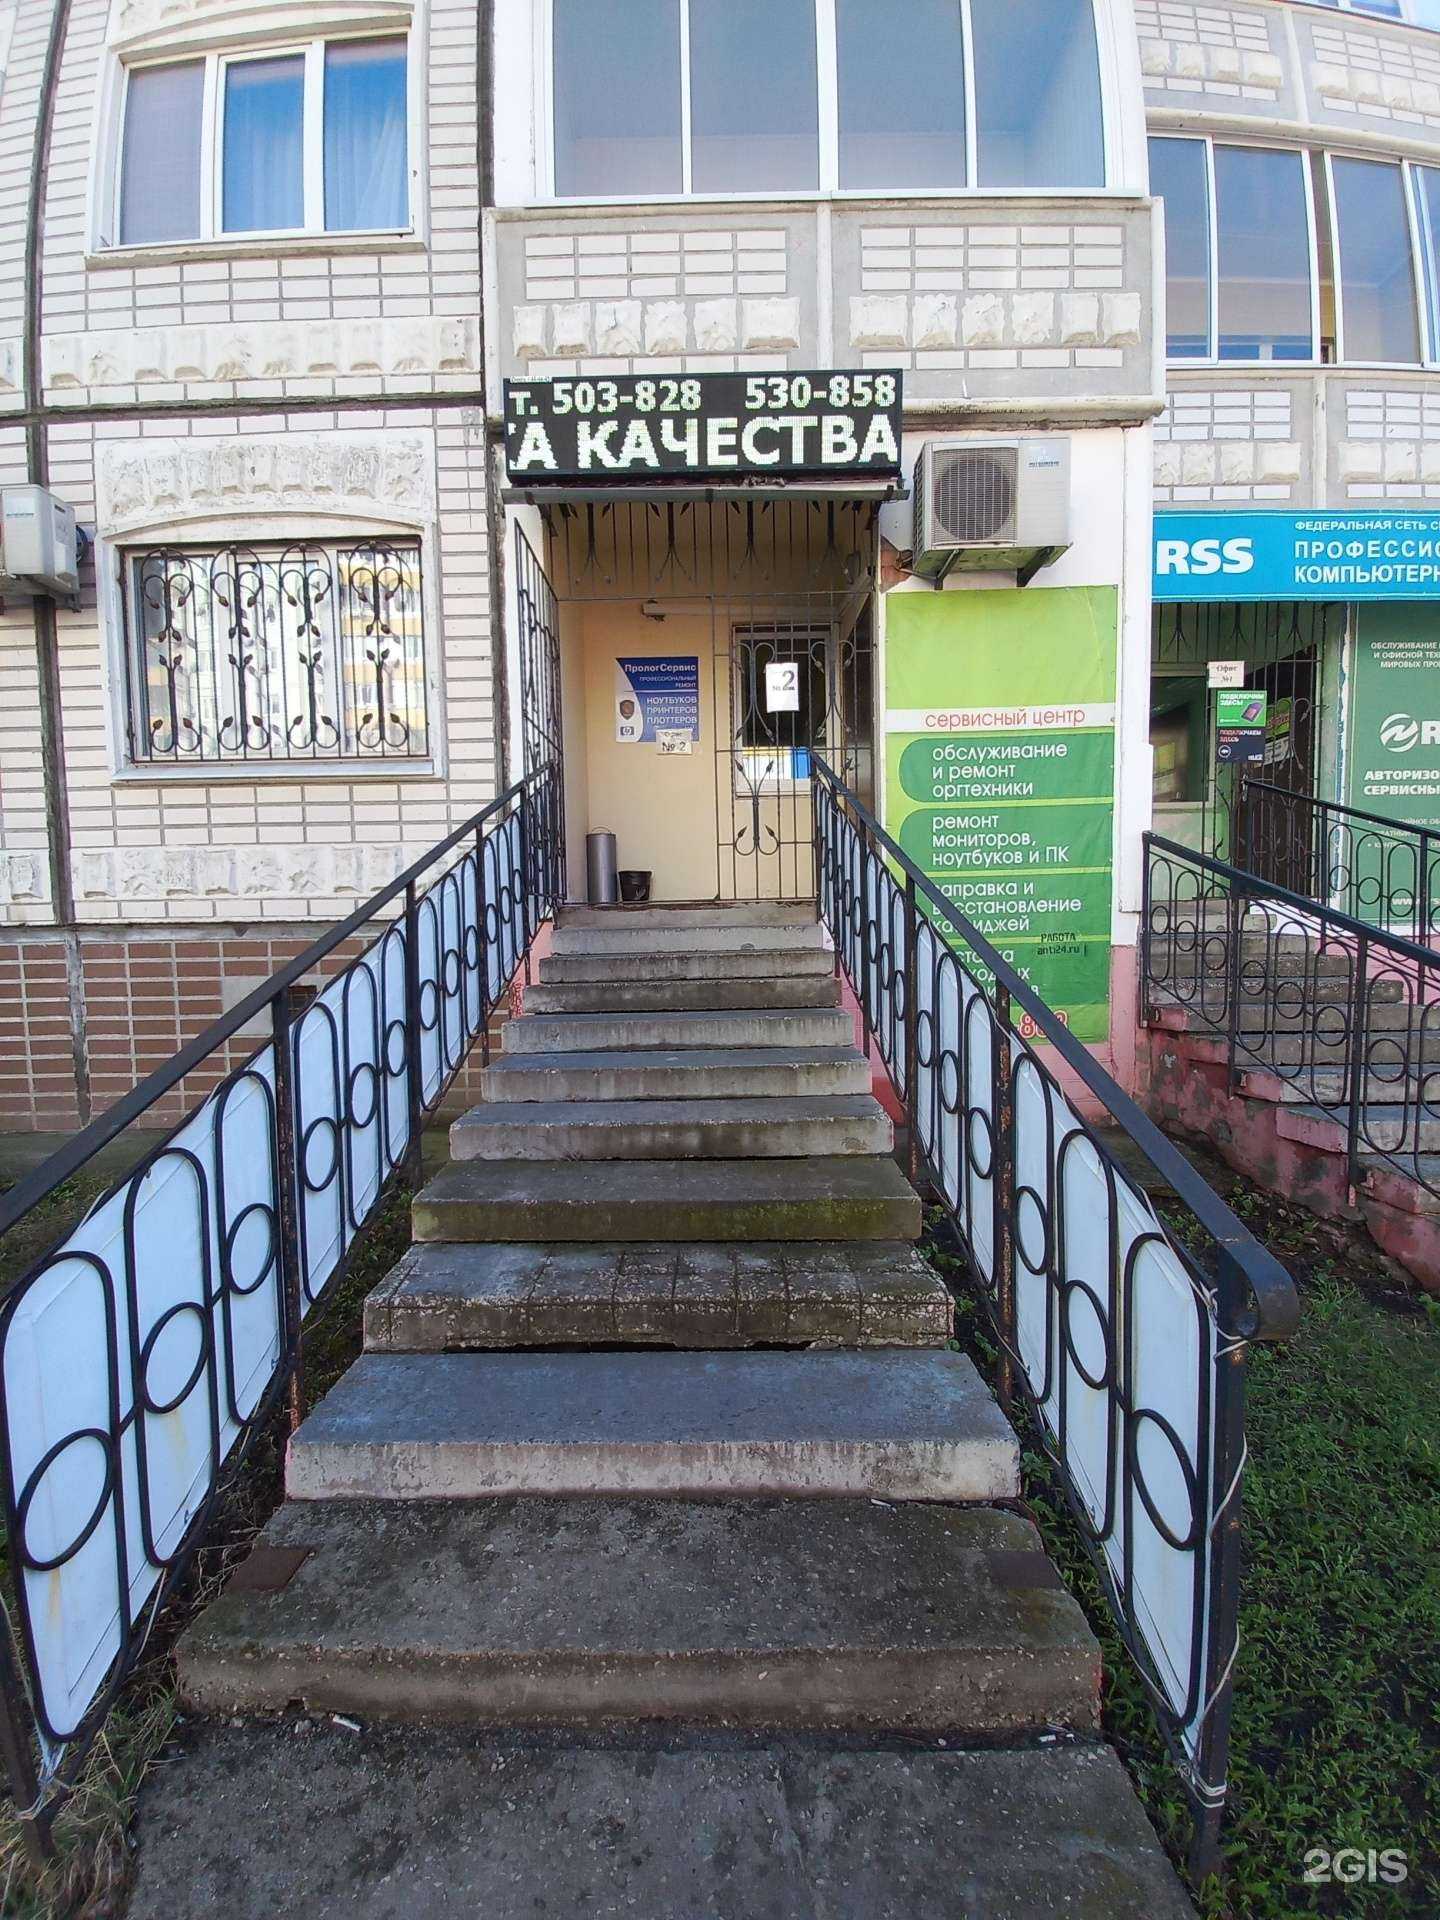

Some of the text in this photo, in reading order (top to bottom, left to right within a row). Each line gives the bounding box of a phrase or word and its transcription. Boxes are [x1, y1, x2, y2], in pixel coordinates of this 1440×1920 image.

[552, 380, 701, 415] 503-828
[744, 375, 897, 410] 530-858
[508, 414, 899, 471] А КАЧЕСТВА
[1295, 520, 1392, 532] ФЕДЕРАЛЬНАЯ
[1394, 520, 1427, 531] СЕТЬ
[1156, 537, 1255, 575] RSS
[1370, 641, 1438, 650] ОБСЛУЖИВАНИЕ
[1381, 650, 1423, 659] ОФИСНОЙ
[1424, 651, 1440, 659] ТЕХ
[1422, 660, 1440, 668] ПРО
[646, 696, 697, 705] НОУТБУКОВ
[646, 706, 697, 715] ПРИНТЕРОВ
[646, 716, 697, 725] ПЛОТТЕРОВ
[925, 708, 1086, 730] сервисный центр
[932, 743, 1068, 763] обслуживание
[932, 764, 1016, 782] и ремонт
[932, 782, 1034, 800] оргтехники
[932, 815, 999, 832] ремонт
[932, 833, 1036, 849] мониторов,
[932, 846, 1070, 868] ноутбуков и ПК
[1024, 882, 1034, 895] и
[932, 899, 1082, 915] всстановление
